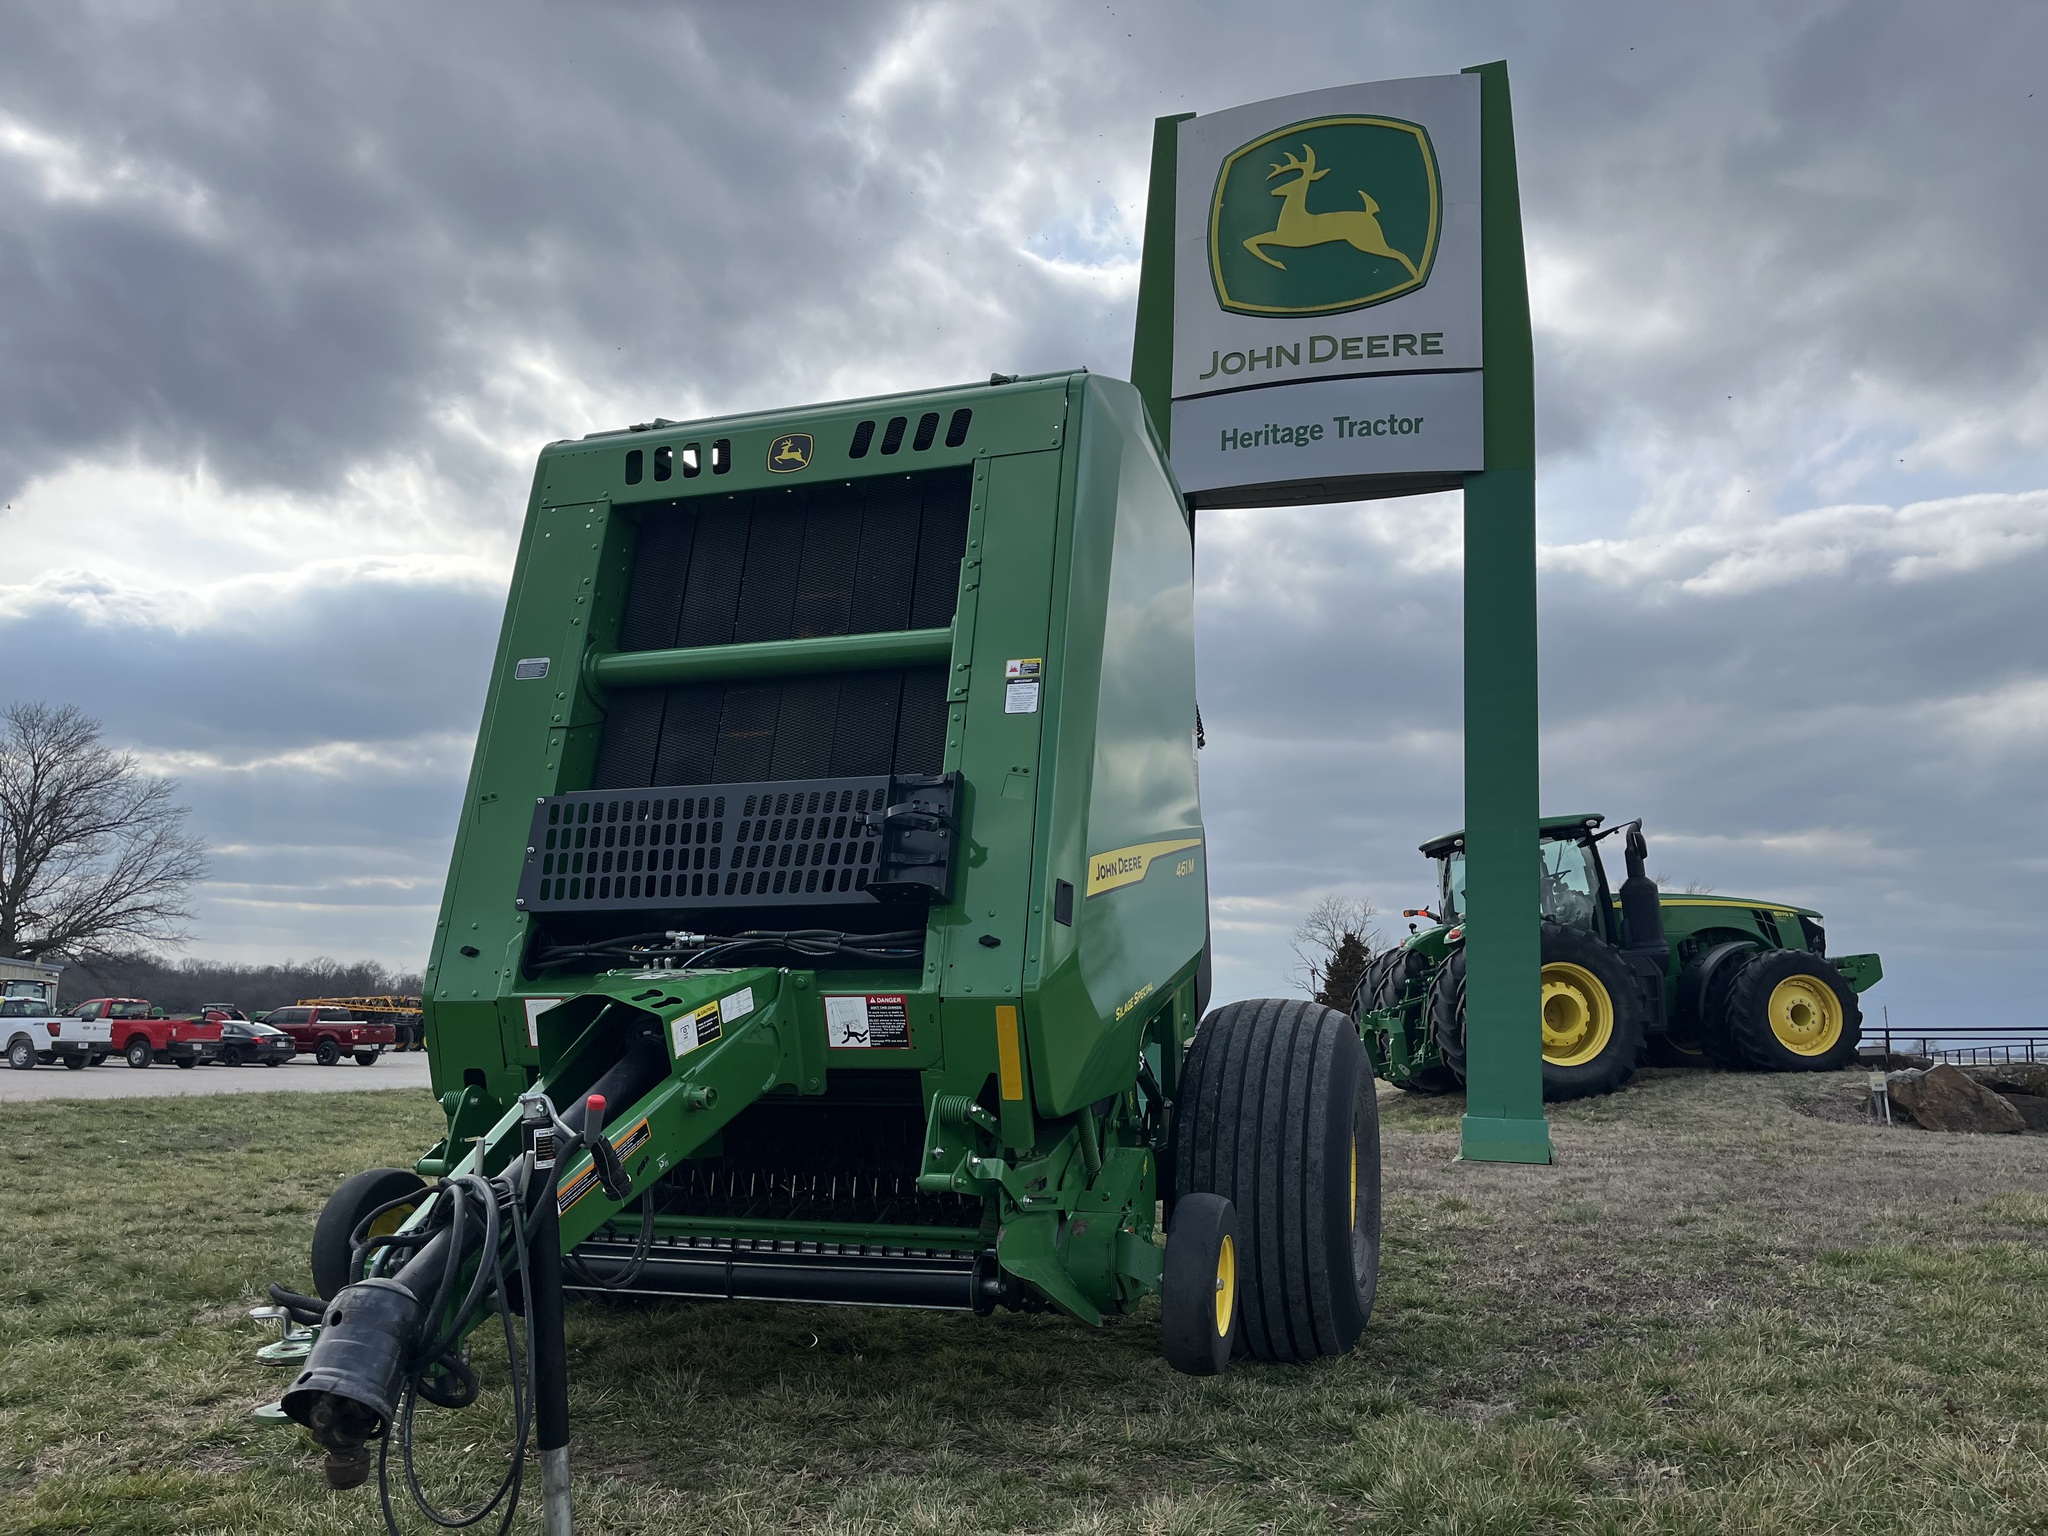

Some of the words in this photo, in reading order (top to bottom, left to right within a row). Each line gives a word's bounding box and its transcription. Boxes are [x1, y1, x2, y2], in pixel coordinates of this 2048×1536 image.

[1199, 342, 1301, 380] JOHN
[1308, 332, 1444, 364] DEERE
[1220, 423, 1325, 452] Heritage
[1333, 413, 1424, 439] Tractor
[1096, 863, 1117, 881] JOHN
[1118, 856, 1142, 874] DEERE
[1175, 858, 1196, 878] 461M
[1115, 996, 1134, 1022] SILAGE
[1134, 981, 1154, 1006] SPECIAL
